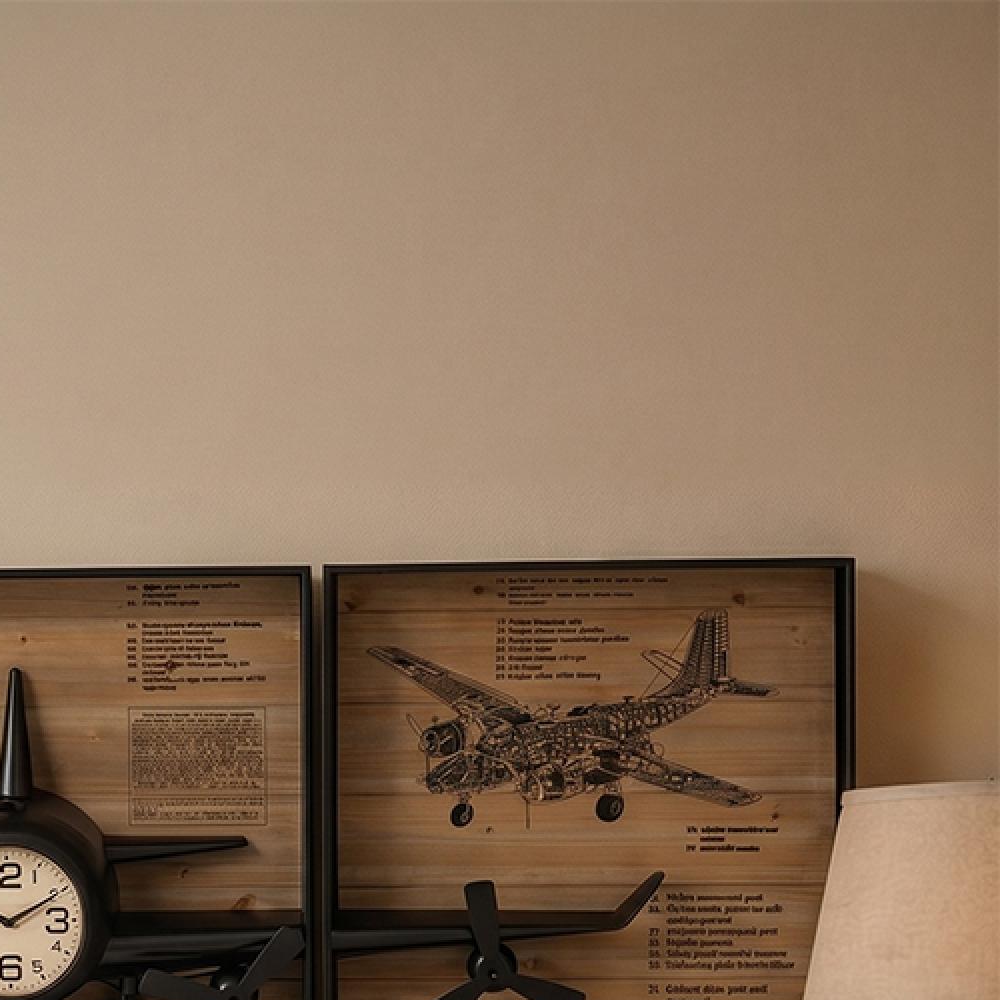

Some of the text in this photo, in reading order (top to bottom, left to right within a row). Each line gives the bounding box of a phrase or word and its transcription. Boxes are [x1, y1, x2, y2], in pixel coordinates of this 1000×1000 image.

[32, 869, 37, 884] 1
[45, 908, 69, 934] 3
[51, 940, 61, 952] 4
[0, 954, 22, 981] 6
[31, 960, 42, 974] 5
